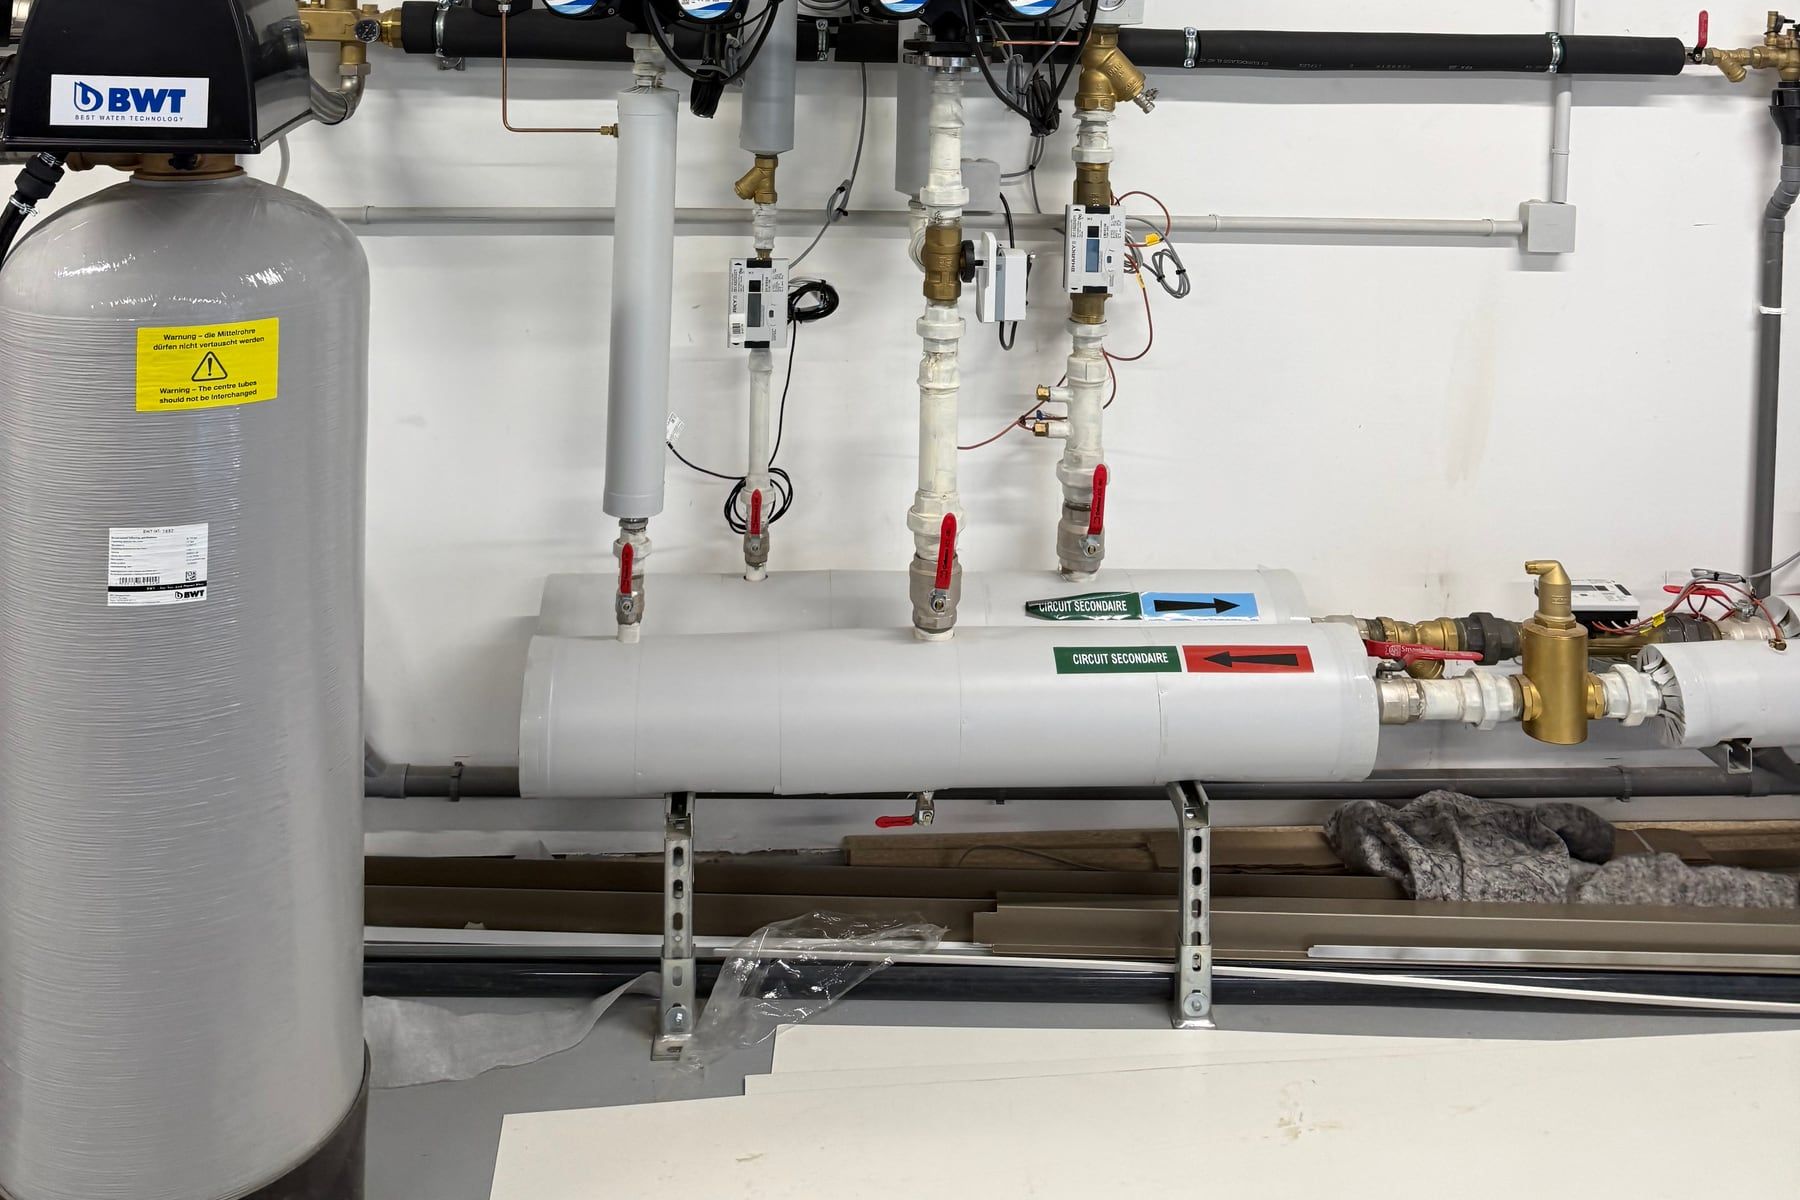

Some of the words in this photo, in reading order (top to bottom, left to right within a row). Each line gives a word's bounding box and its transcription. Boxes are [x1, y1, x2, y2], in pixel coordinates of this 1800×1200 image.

[108, 87, 186, 113] BWT
[204, 331, 216, 339] die
[217, 328, 256, 337] Mittelrohre
[153, 342, 178, 351] dürfen
[199, 339, 238, 348] vertauscht
[239, 336, 265, 344] werden
[160, 387, 190, 395] Warning
[213, 383, 237, 391] centre
[238, 380, 257, 388] tubes
[159, 396, 184, 404] should
[186, 394, 199, 402] not
[200, 393, 210, 401] be
[184, 590, 205, 598] BWT
[1039, 600, 1072, 612] CIRCUIT
[1074, 600, 1127, 612] SECONDAIRE
[1072, 653, 1109, 665] CIRCUIT
[1111, 652, 1169, 664] SECONDAIRE
